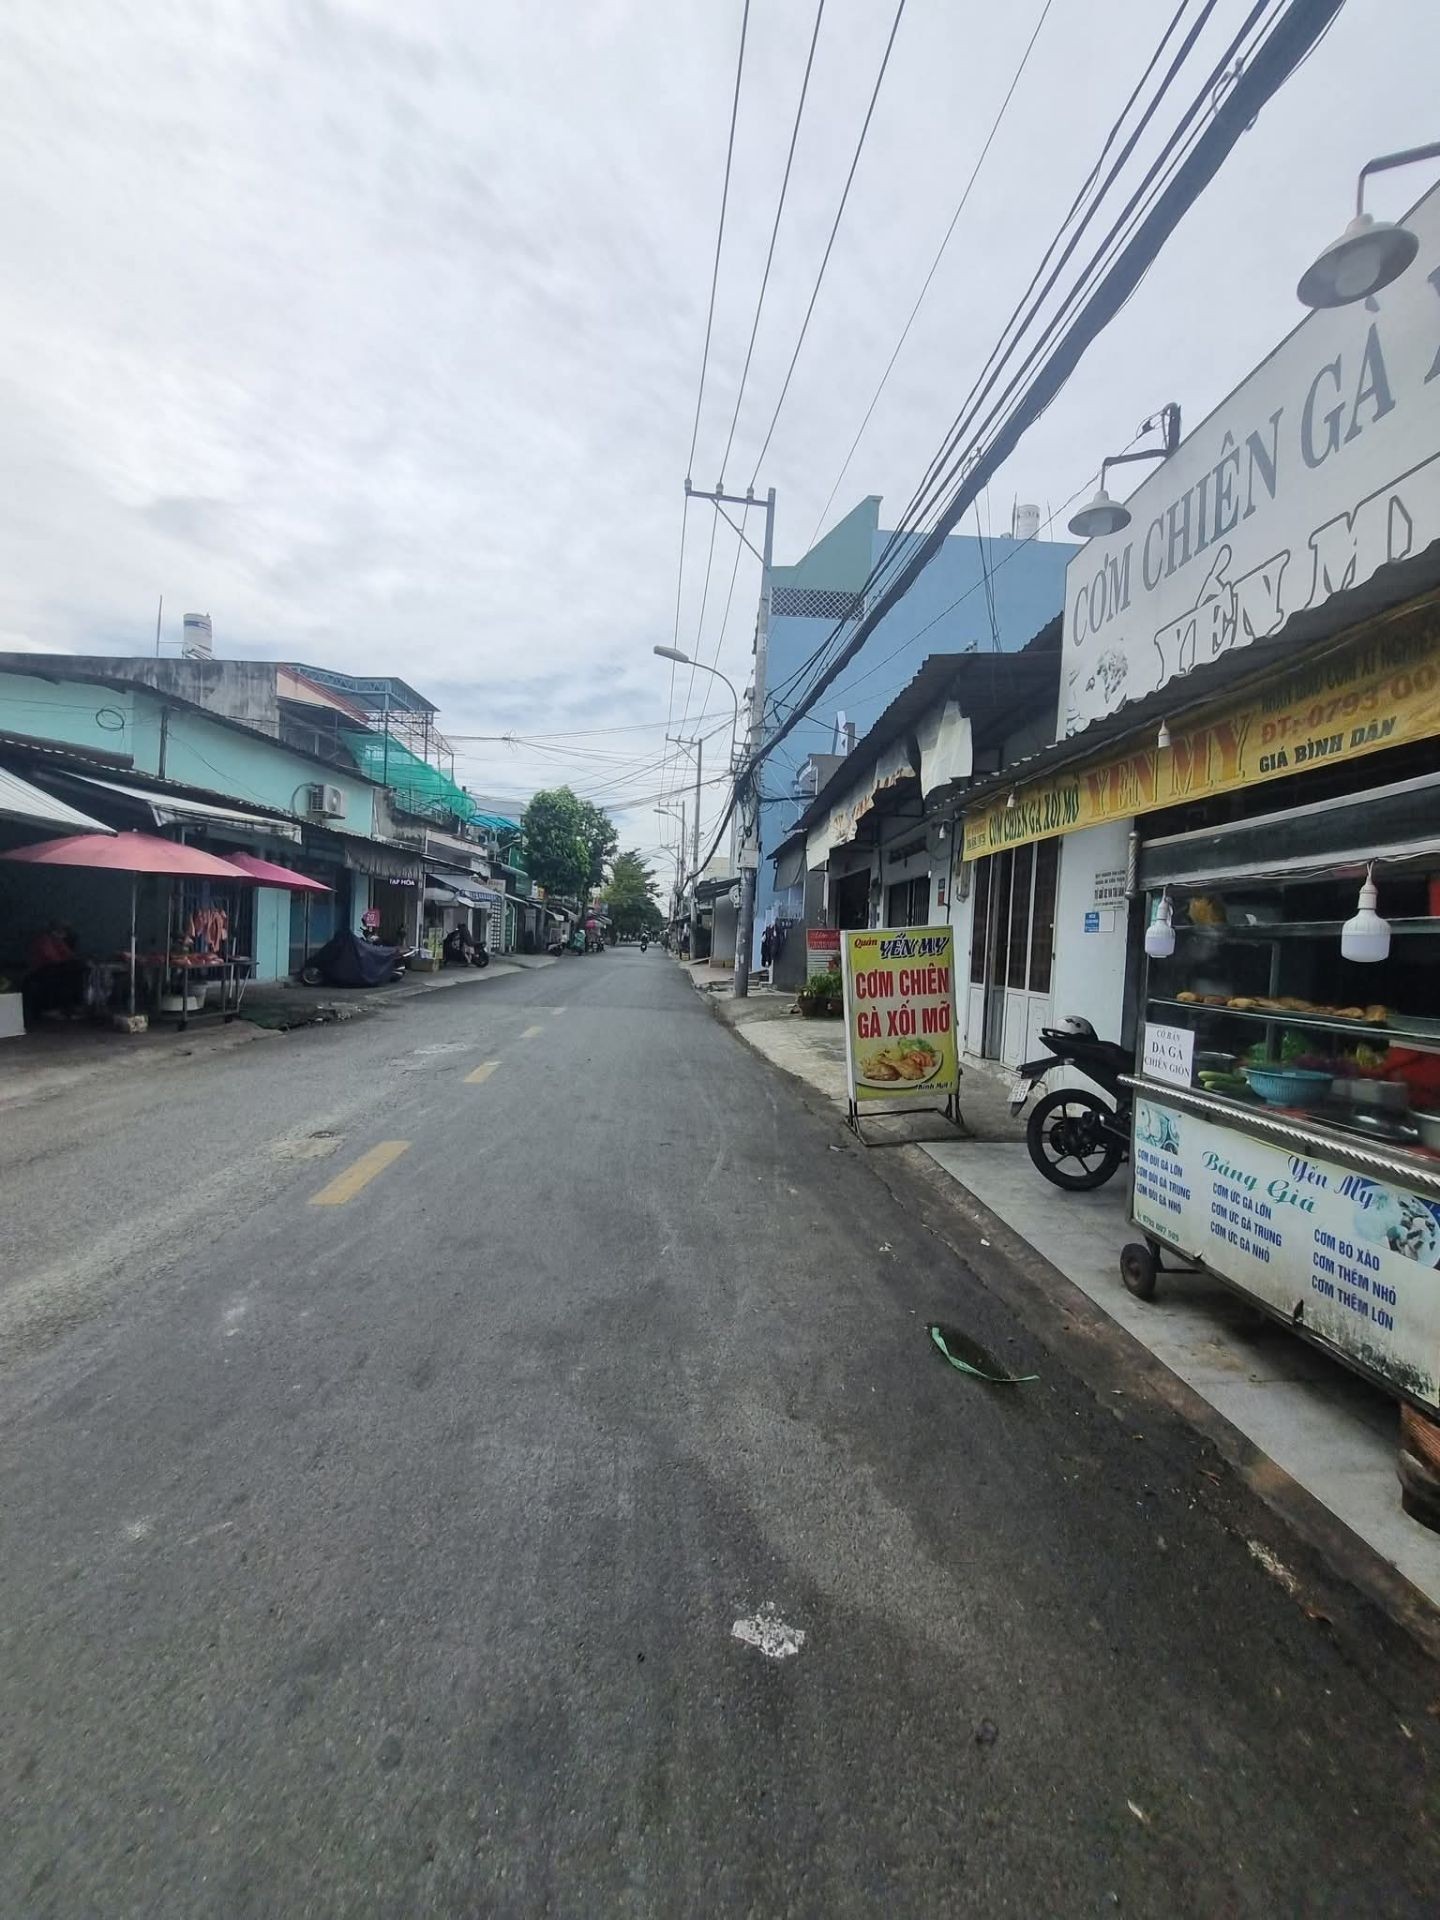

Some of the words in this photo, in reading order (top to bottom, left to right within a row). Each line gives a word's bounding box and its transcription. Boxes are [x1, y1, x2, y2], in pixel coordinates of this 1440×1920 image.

[1073, 542, 1133, 646] CƠM
[1142, 407, 1284, 591] CHIÊN
[1259, 746, 1288, 773] GIÁ
[1294, 733, 1344, 764] BÌNH
[1350, 716, 1397, 748] DÂN
[880, 933, 917, 959] YẾN
[918, 937, 950, 958] MY
[855, 968, 894, 999] CƠM
[899, 963, 950, 997] CHIÊN
[857, 1005, 882, 1039] GÀ
[886, 1000, 917, 1037] XỐI
[922, 1001, 950, 1034] MỠ
[1212, 1182, 1229, 1200] CƠM
[1210, 1220, 1227, 1240] CƠM
[1211, 1201, 1228, 1220] CƠM
[1253, 1222, 1282, 1247] TRUNG
[1314, 1228, 1336, 1252] CƠM
[1357, 1246, 1380, 1272] XÀO
[1312, 1251, 1335, 1276] CƠM
[1372, 1281, 1397, 1306] NHỎ
[1311, 1274, 1334, 1298] CƠM
[1371, 1305, 1394, 1332] LỚN
